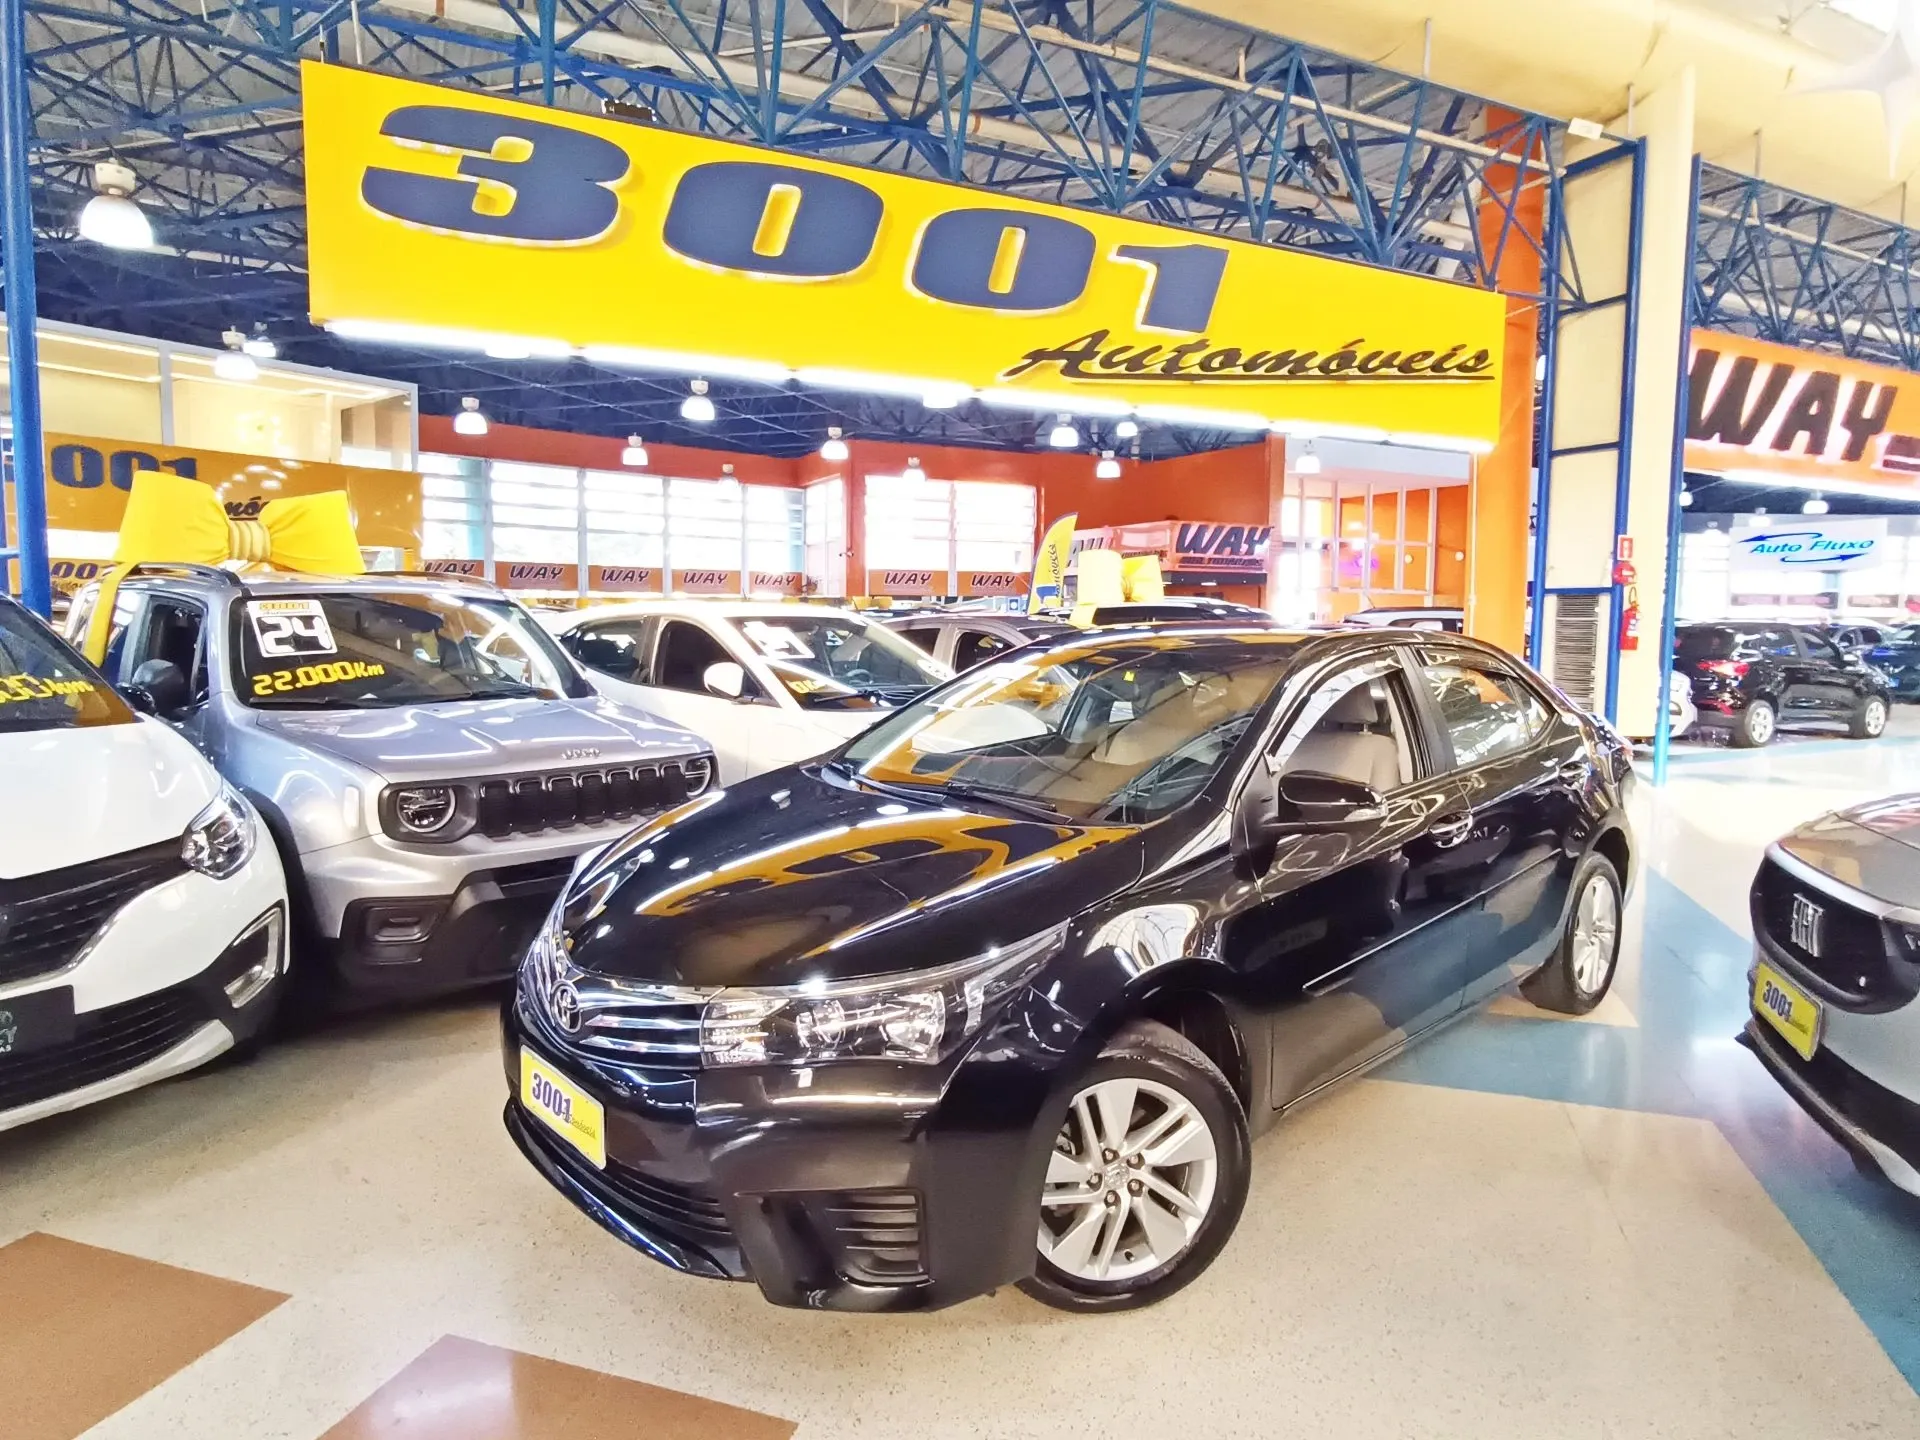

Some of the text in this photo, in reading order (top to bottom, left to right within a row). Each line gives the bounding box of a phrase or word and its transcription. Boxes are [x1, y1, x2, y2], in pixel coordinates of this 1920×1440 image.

[361, 105, 1230, 334] 3001
[1002, 329, 1496, 381] Automóveis
[1688, 348, 1898, 462] WAY
[1176, 523, 1273, 556] WAY
[1750, 540, 1875, 554] Auto Fluxo
[509, 564, 565, 580] WAY
[601, 568, 650, 583] WAY
[683, 571, 729, 585] WAY
[754, 573, 797, 586] WAY
[884, 571, 933, 585] WAY
[971, 573, 1016, 587] WAY
[261, 615, 333, 653] 24
[532, 1072, 572, 1124] 3001
